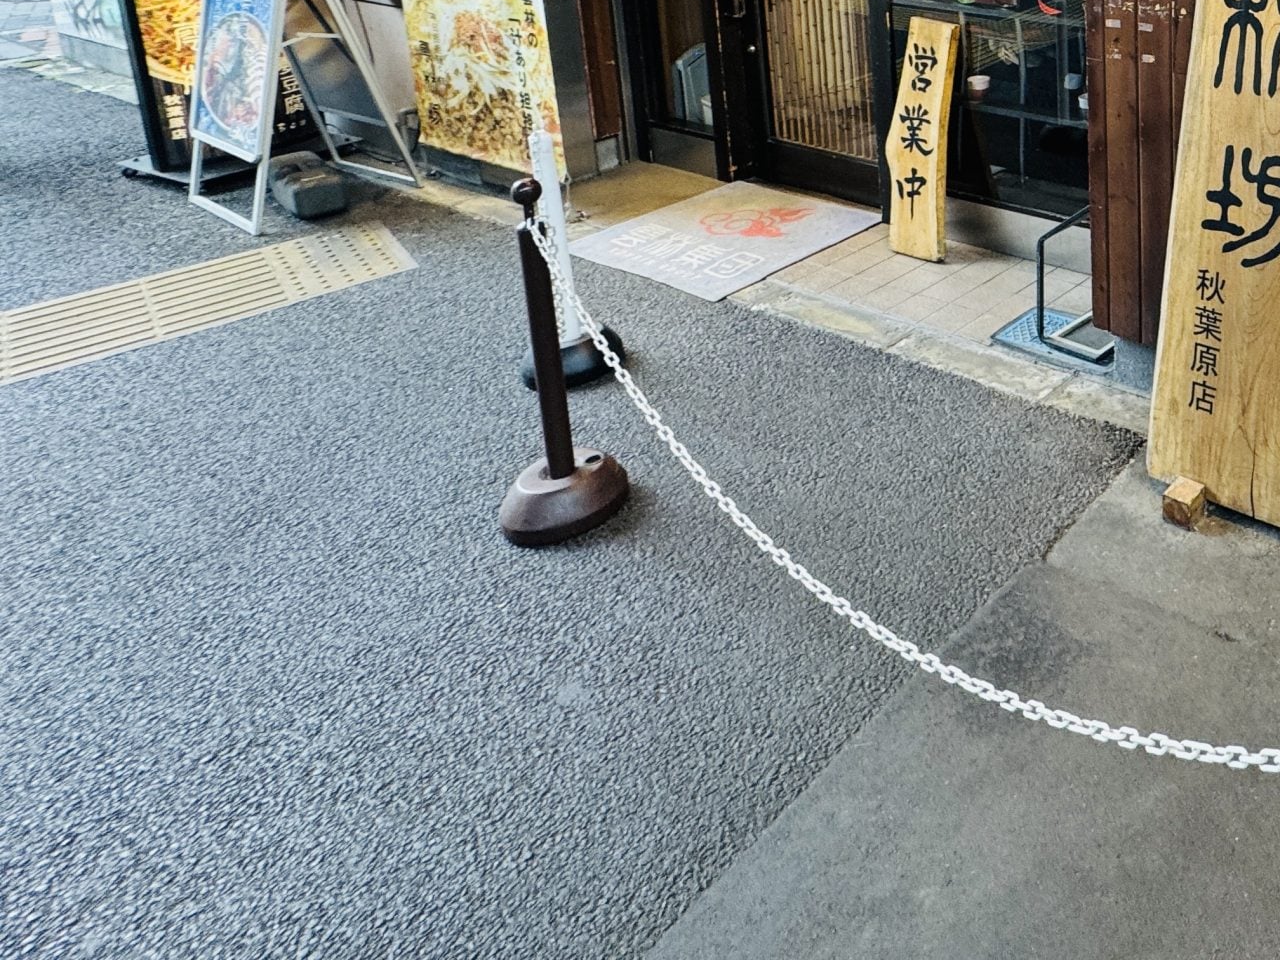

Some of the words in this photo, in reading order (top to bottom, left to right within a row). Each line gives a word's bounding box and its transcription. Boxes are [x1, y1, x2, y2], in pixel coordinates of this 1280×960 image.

[895, 43, 938, 221] 営業中
[1188, 268, 1226, 416] 秋葉原店
